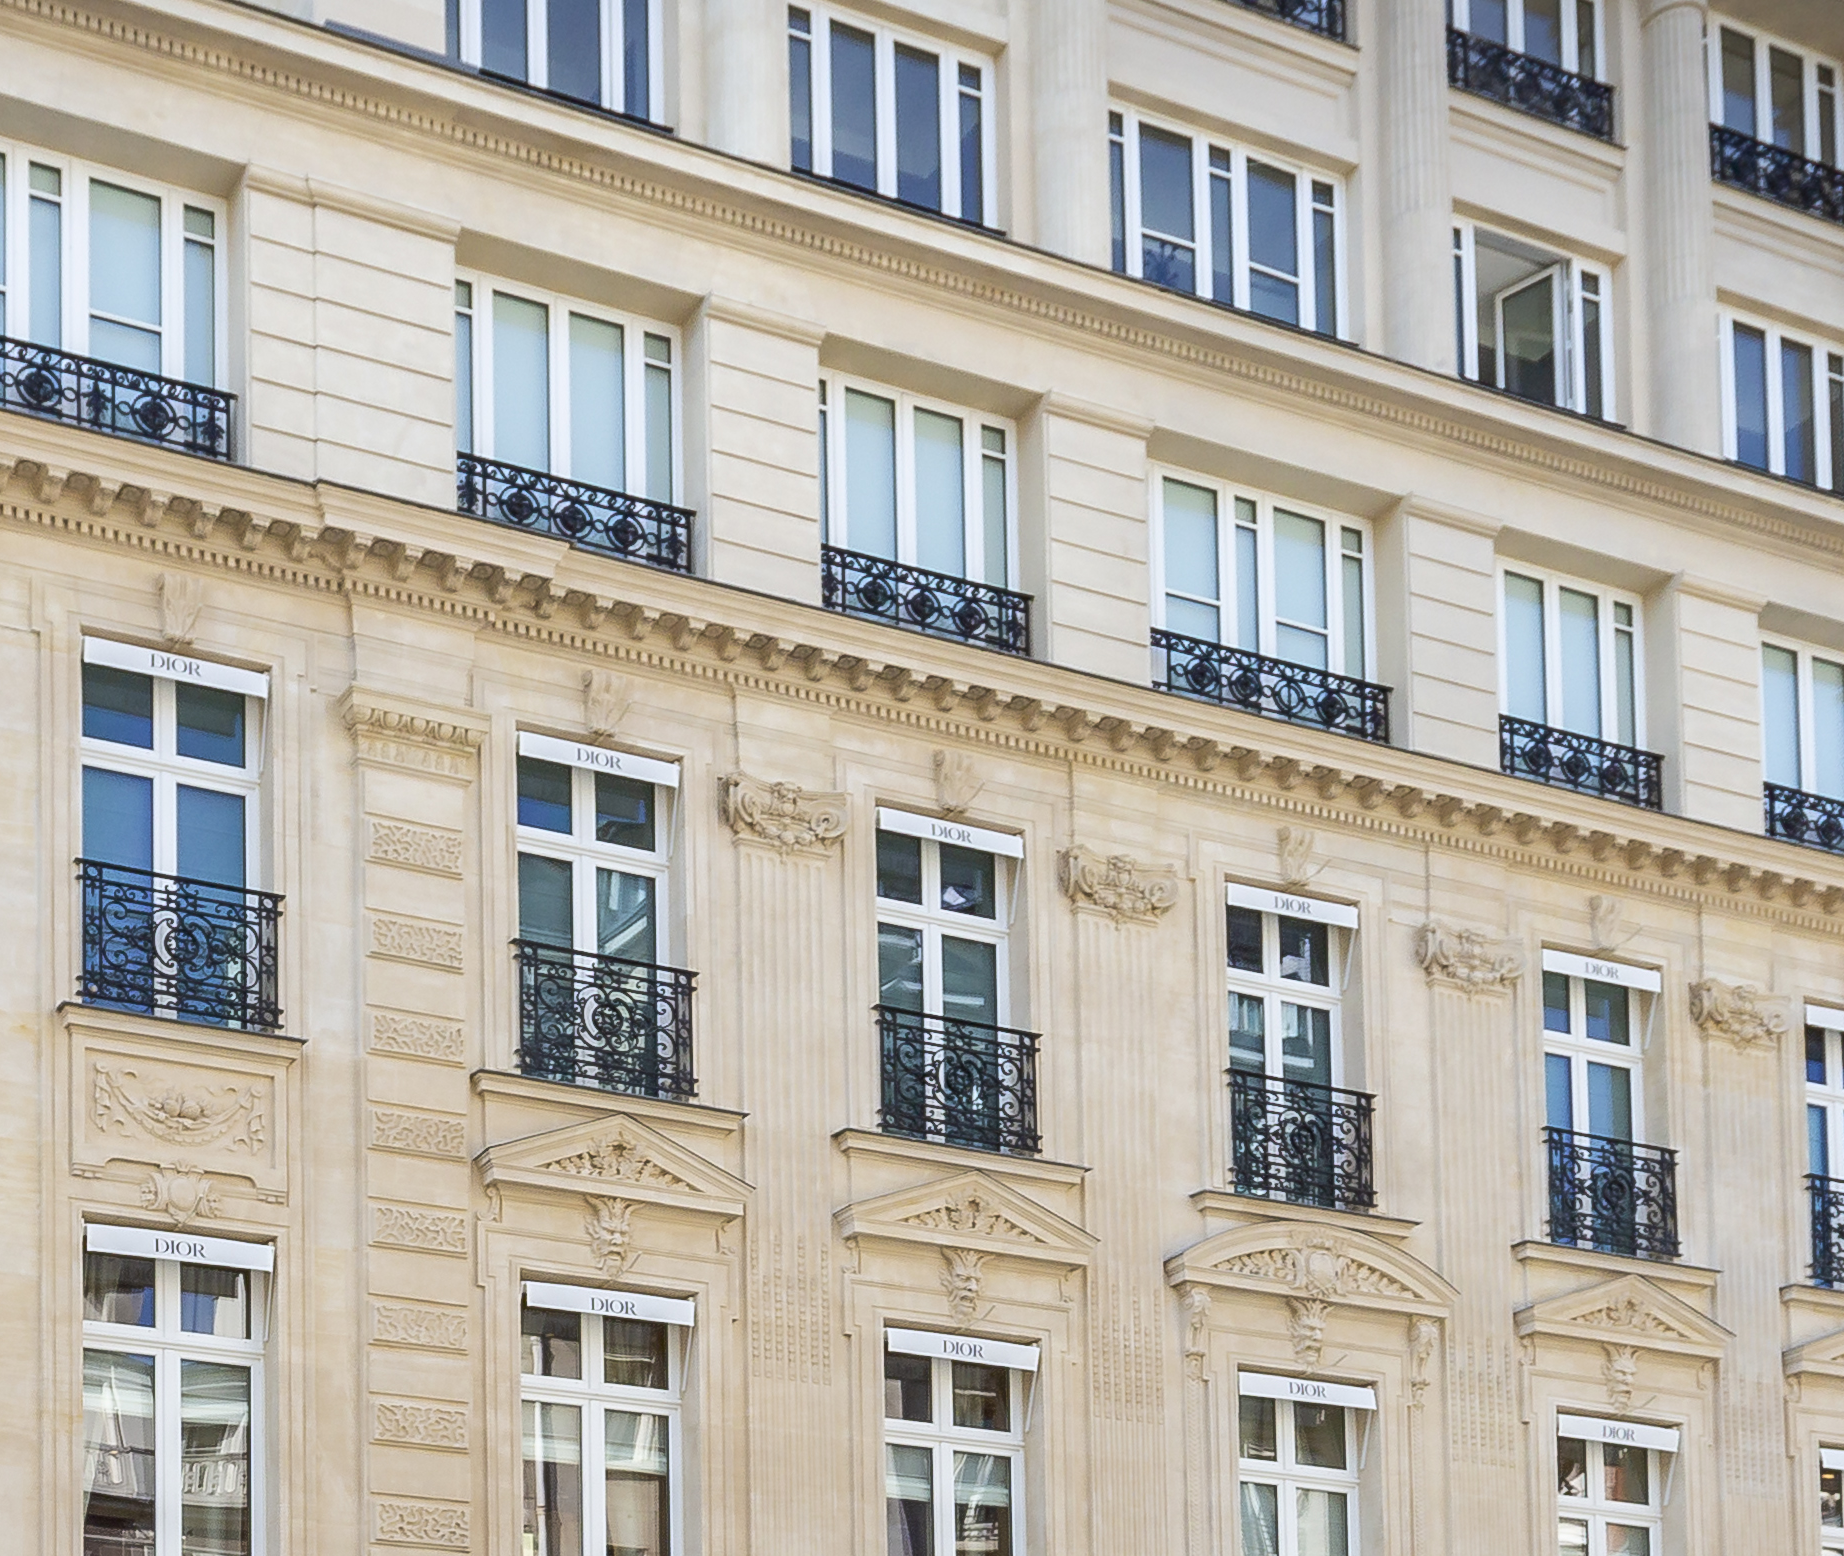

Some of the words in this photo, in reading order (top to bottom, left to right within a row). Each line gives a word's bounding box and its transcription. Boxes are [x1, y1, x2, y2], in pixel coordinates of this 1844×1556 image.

[151, 653, 201, 676] DIOR
[577, 747, 622, 770] DIOR
[931, 822, 972, 844] DIOR
[1274, 895, 1312, 914] DIOR
[1584, 961, 1619, 979] DIOR
[154, 1237, 207, 1259] DIOR
[590, 1296, 638, 1317] DIOR
[942, 1340, 984, 1360] DIOR
[1288, 1380, 1327, 1399] DIOR
[1602, 1424, 1636, 1442] DIOR
